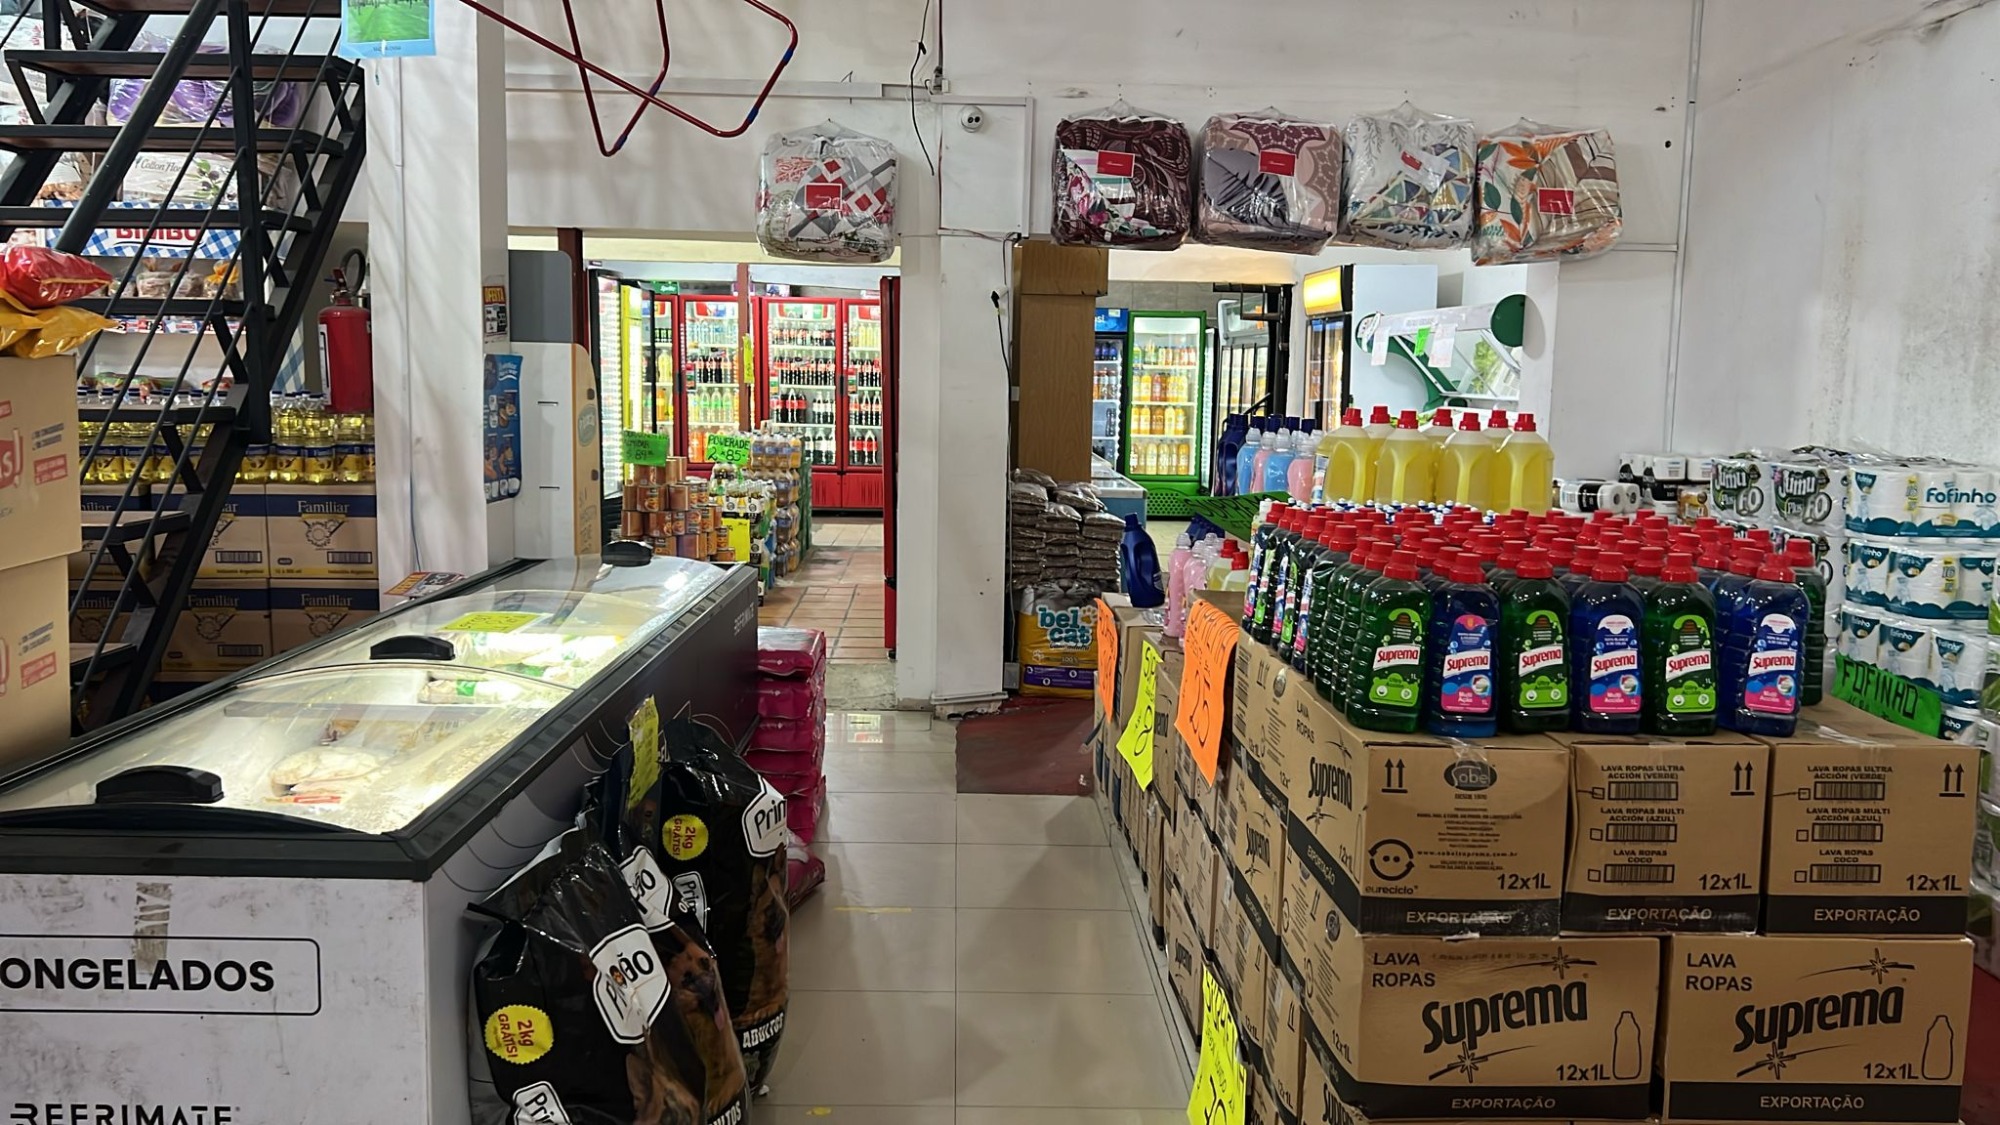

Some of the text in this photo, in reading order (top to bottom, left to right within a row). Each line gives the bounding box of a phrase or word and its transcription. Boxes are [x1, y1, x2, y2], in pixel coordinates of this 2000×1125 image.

[297, 500, 350, 514] Familiar
[188, 594, 239, 608] Familiar
[301, 593, 352, 607] Familiar
[1038, 606, 1080, 628] bel
[1049, 626, 1090, 643] cat
[1377, 649, 1419, 663] Suprema
[1447, 655, 1489, 671] Suprema
[1521, 649, 1562, 667] Suprema
[1594, 654, 1636, 672] Suprema
[1668, 653, 1710, 672] Suprema
[1753, 655, 1795, 670] Suprema
[1308, 756, 1353, 812] Suprema
[1497, 873, 1552, 890] 12x1L
[1698, 873, 1752, 890] 12x1L
[1906, 875, 1962, 891] 12x1L
[1607, 906, 1712, 922] EXPORTAÇÃO
[1813, 906, 1921, 923] EXPORTAÇÃO
[1373, 952, 1421, 966] LAVA
[1686, 953, 1736, 968] LAVA
[1372, 972, 1436, 987] ROPAS
[1686, 976, 1753, 991] ROPAS
[1422, 981, 1588, 1053] Suprema
[1733, 986, 1905, 1053] Suprema
[517, 1020, 534, 1047] 2kg
[743, 1012, 784, 1049] ADULTOS
[1556, 1064, 1612, 1081] 12x1L
[1863, 1062, 1919, 1080] 12x1L
[1451, 1097, 1556, 1110] EXPORTAÇÃO
[1759, 1094, 1865, 1111] EXPORTAÇÃO
